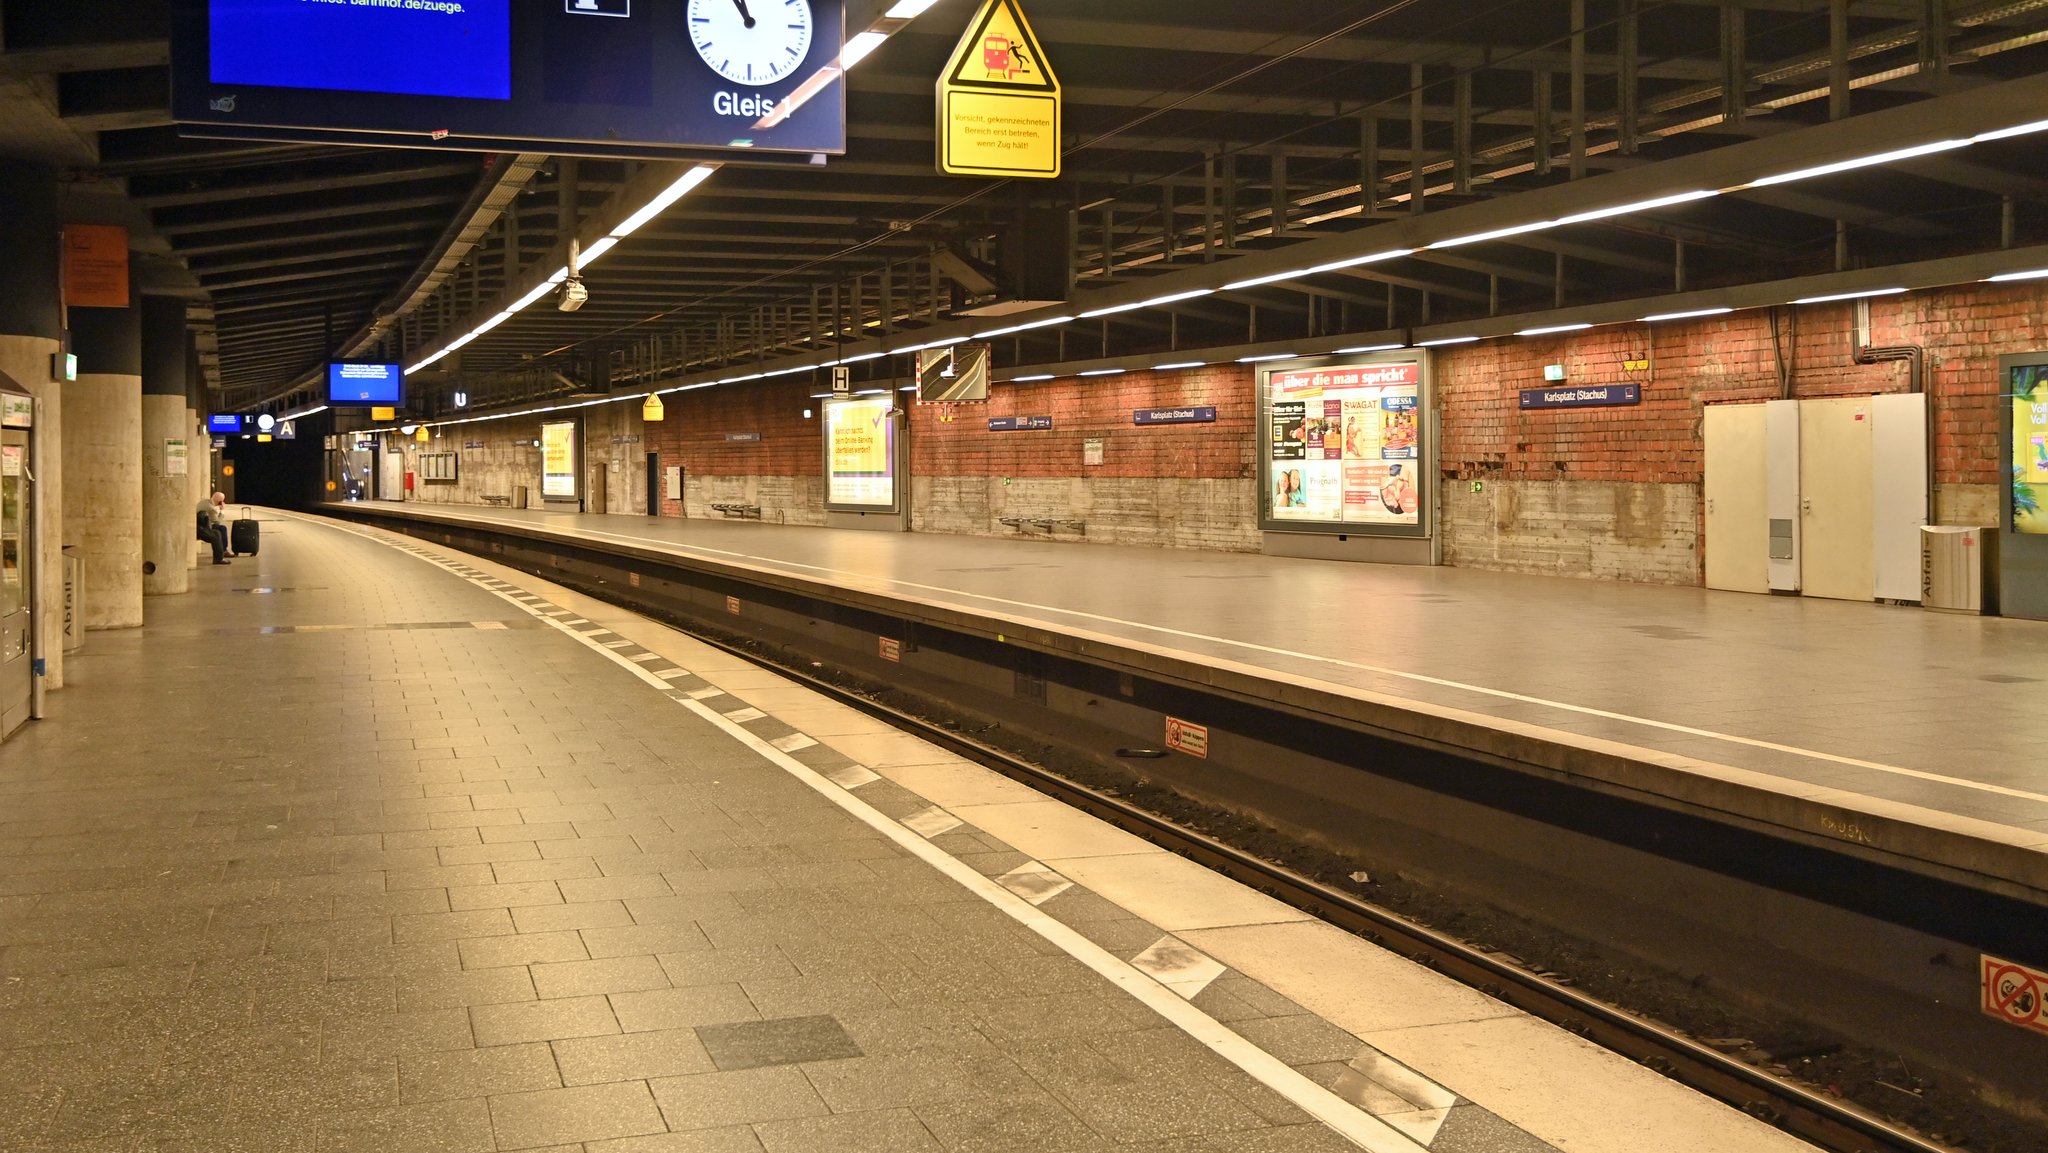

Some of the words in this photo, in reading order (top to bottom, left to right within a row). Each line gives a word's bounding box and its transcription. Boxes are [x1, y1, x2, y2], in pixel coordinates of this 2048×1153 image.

[713, 91, 775, 118] Gleis
[781, 96, 791, 118] 1
[987, 116, 1050, 127] gekennzeichneten
[964, 126, 992, 135] Bereich
[993, 128, 1007, 136] erst
[1008, 129, 1040, 139] betreten,
[997, 140, 1011, 150] Zug
[1012, 141, 1029, 150] hält!
[835, 369, 847, 389] H
[1284, 375, 1310, 388] über
[1312, 373, 1330, 385] die
[1333, 374, 1359, 384] man
[455, 392, 466, 407] U
[1386, 397, 1413, 406] ODESSA
[1544, 391, 1576, 403] Karlsplatz
[1576, 388, 1608, 401] (Stachus)
[1343, 400, 1378, 409] SWAGAT
[1150, 411, 1173, 420] Karlsplatz
[1173, 409, 1195, 418] (Stachus)
[280, 421, 293, 435] A
[1923, 549, 1932, 598] Abfall
[64, 582, 72, 637] Abfall
